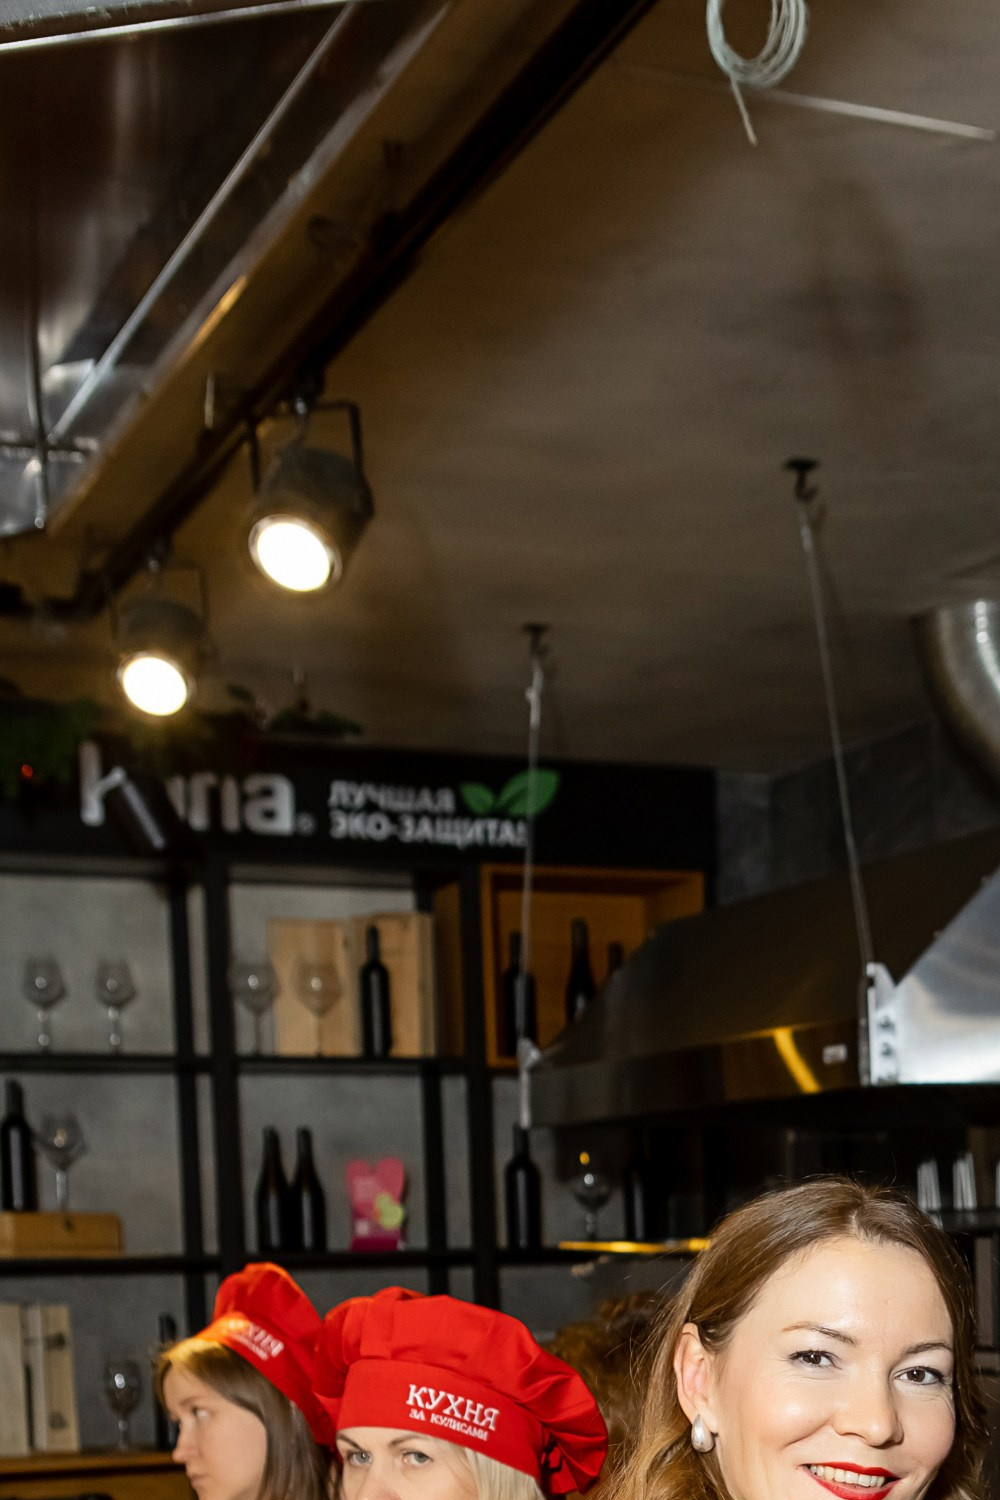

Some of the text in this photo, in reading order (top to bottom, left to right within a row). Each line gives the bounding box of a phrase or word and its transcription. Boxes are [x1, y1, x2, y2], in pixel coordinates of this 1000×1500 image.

[328, 779, 455, 814] ЛУЧШАЯ
[405, 1384, 500, 1431] КУХНЯ
[409, 1408, 489, 1441] ЗА КУЛИСАМИ
